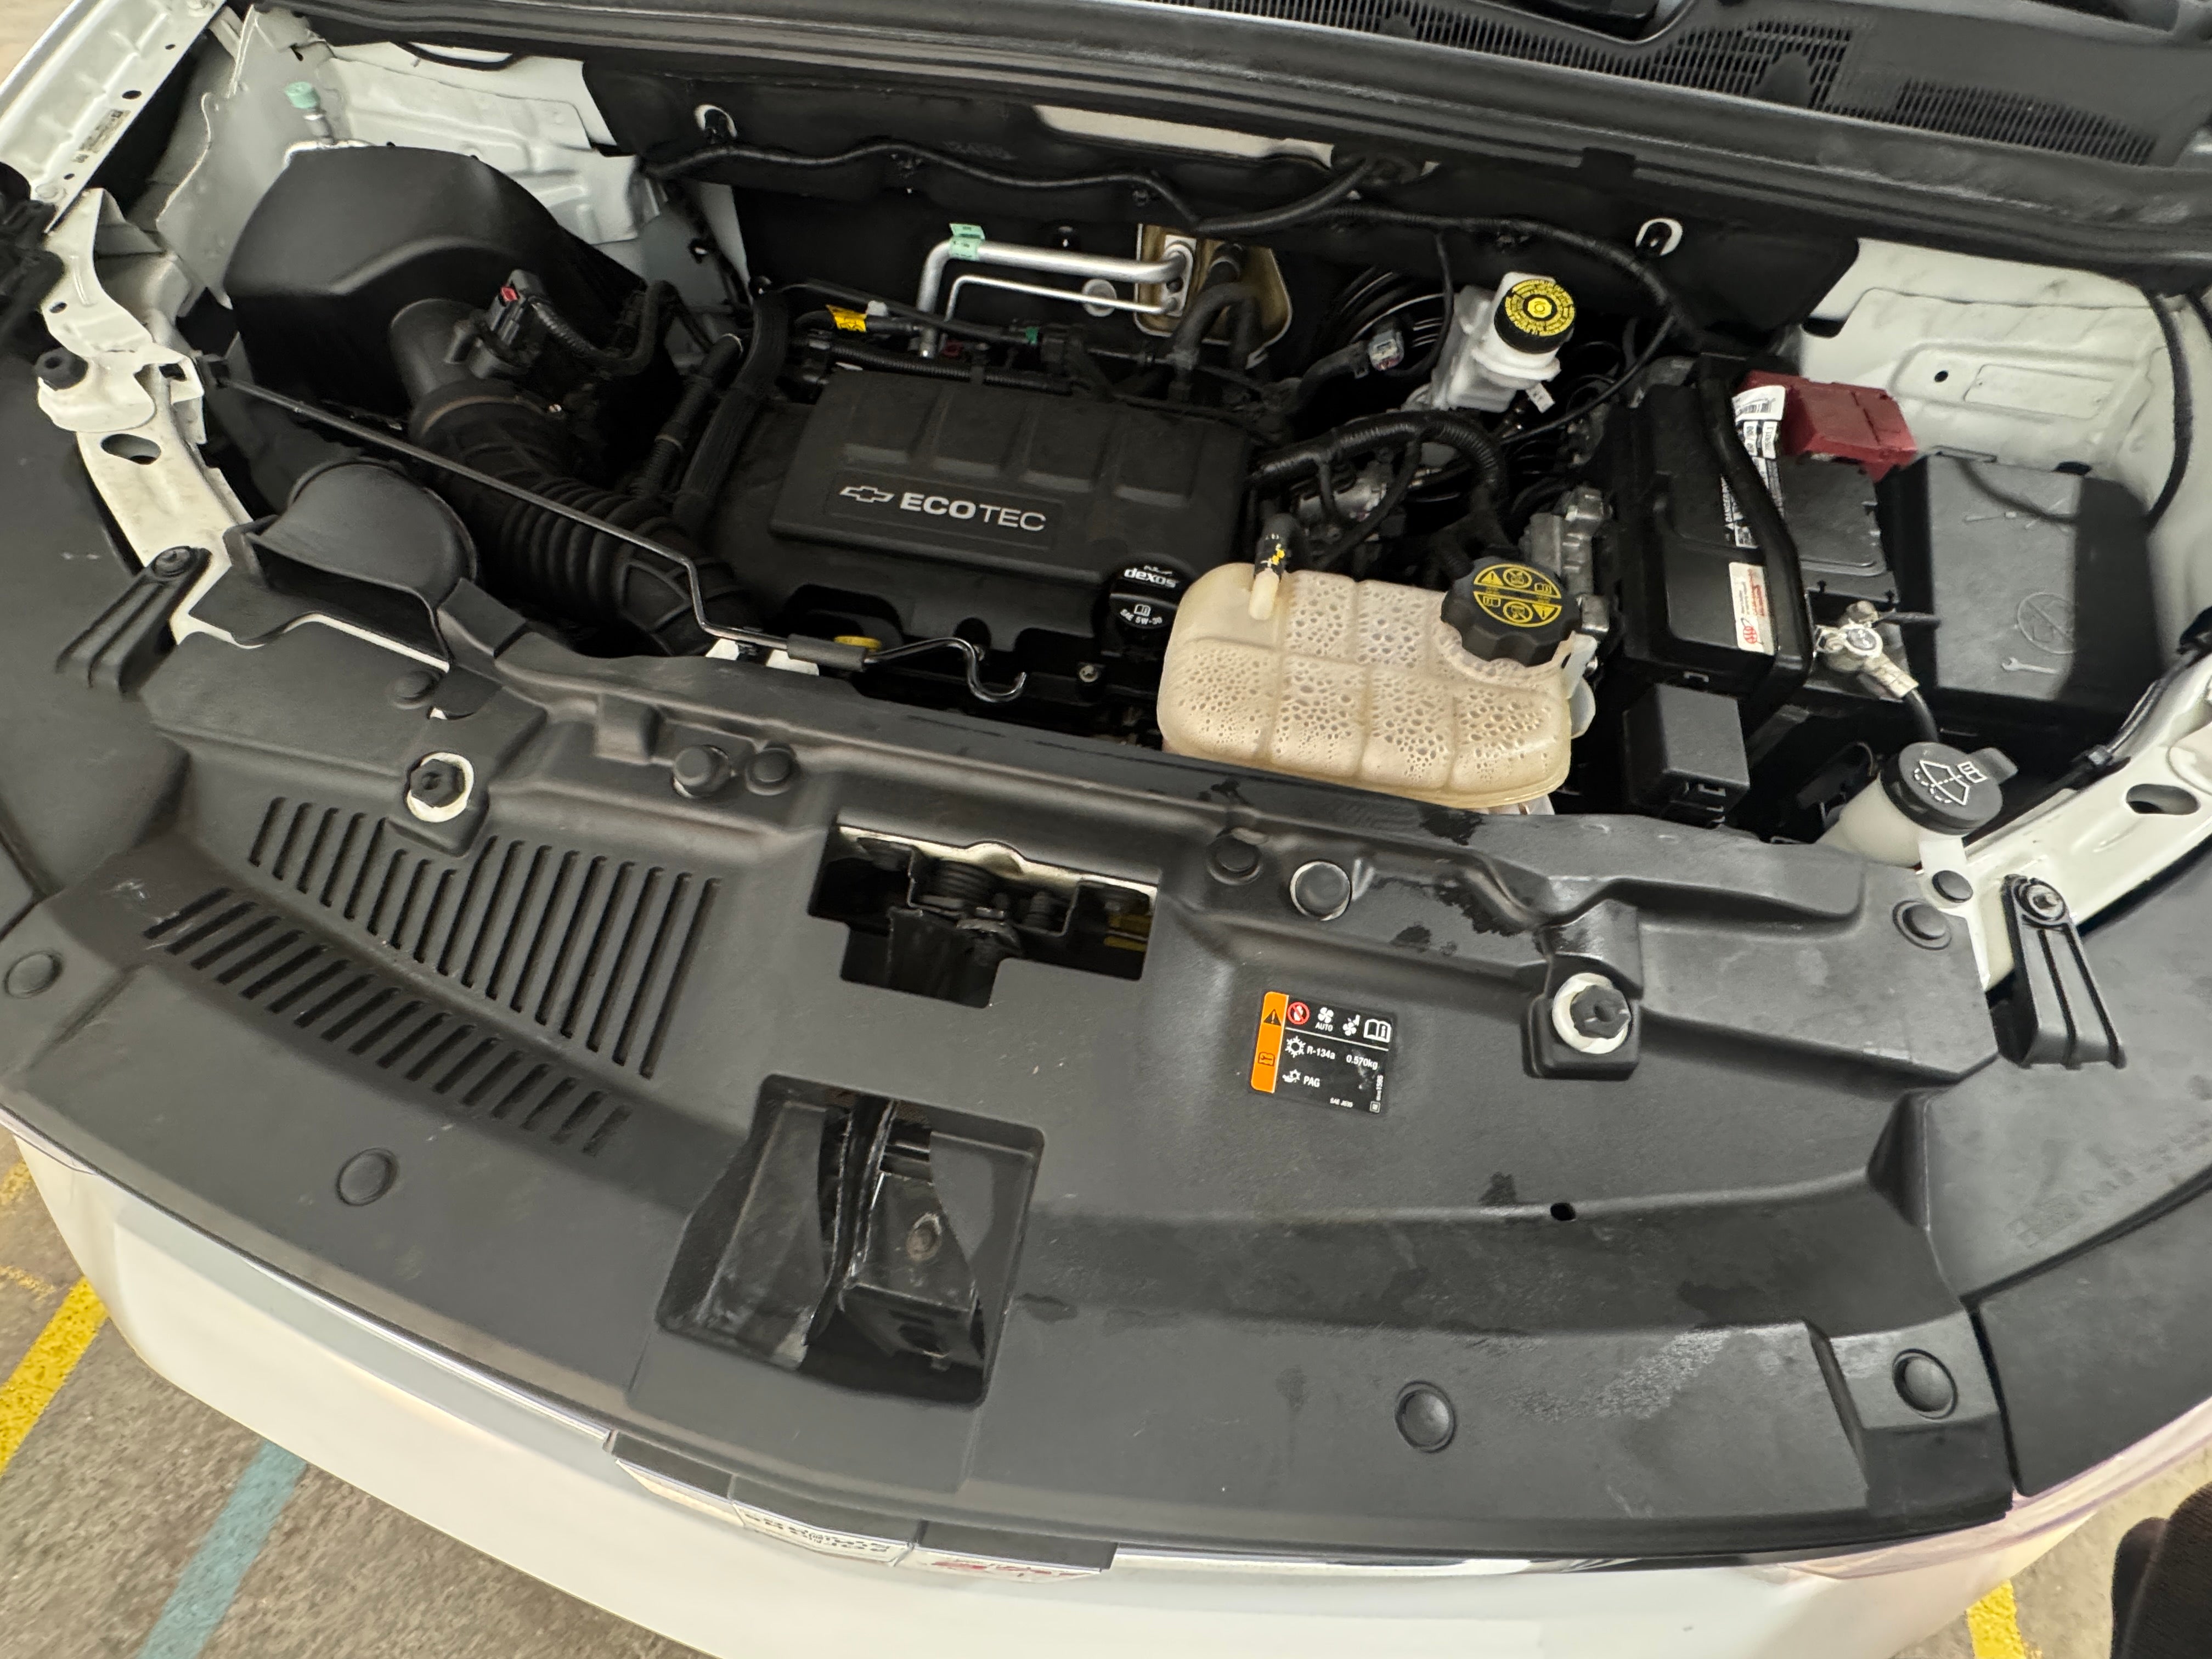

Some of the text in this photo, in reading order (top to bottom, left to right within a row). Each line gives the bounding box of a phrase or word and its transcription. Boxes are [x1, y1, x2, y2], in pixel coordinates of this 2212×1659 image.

[900, 492, 1046, 532] ECOTEC
[1124, 568, 1176, 588] dexos
[1120, 608, 1163, 625] SAE 5W-30
[1315, 1022, 1333, 1032] AUTO
[1307, 1046, 1379, 1070] R-134a 0.570kg
[1304, 1076, 1321, 1088] PAG
